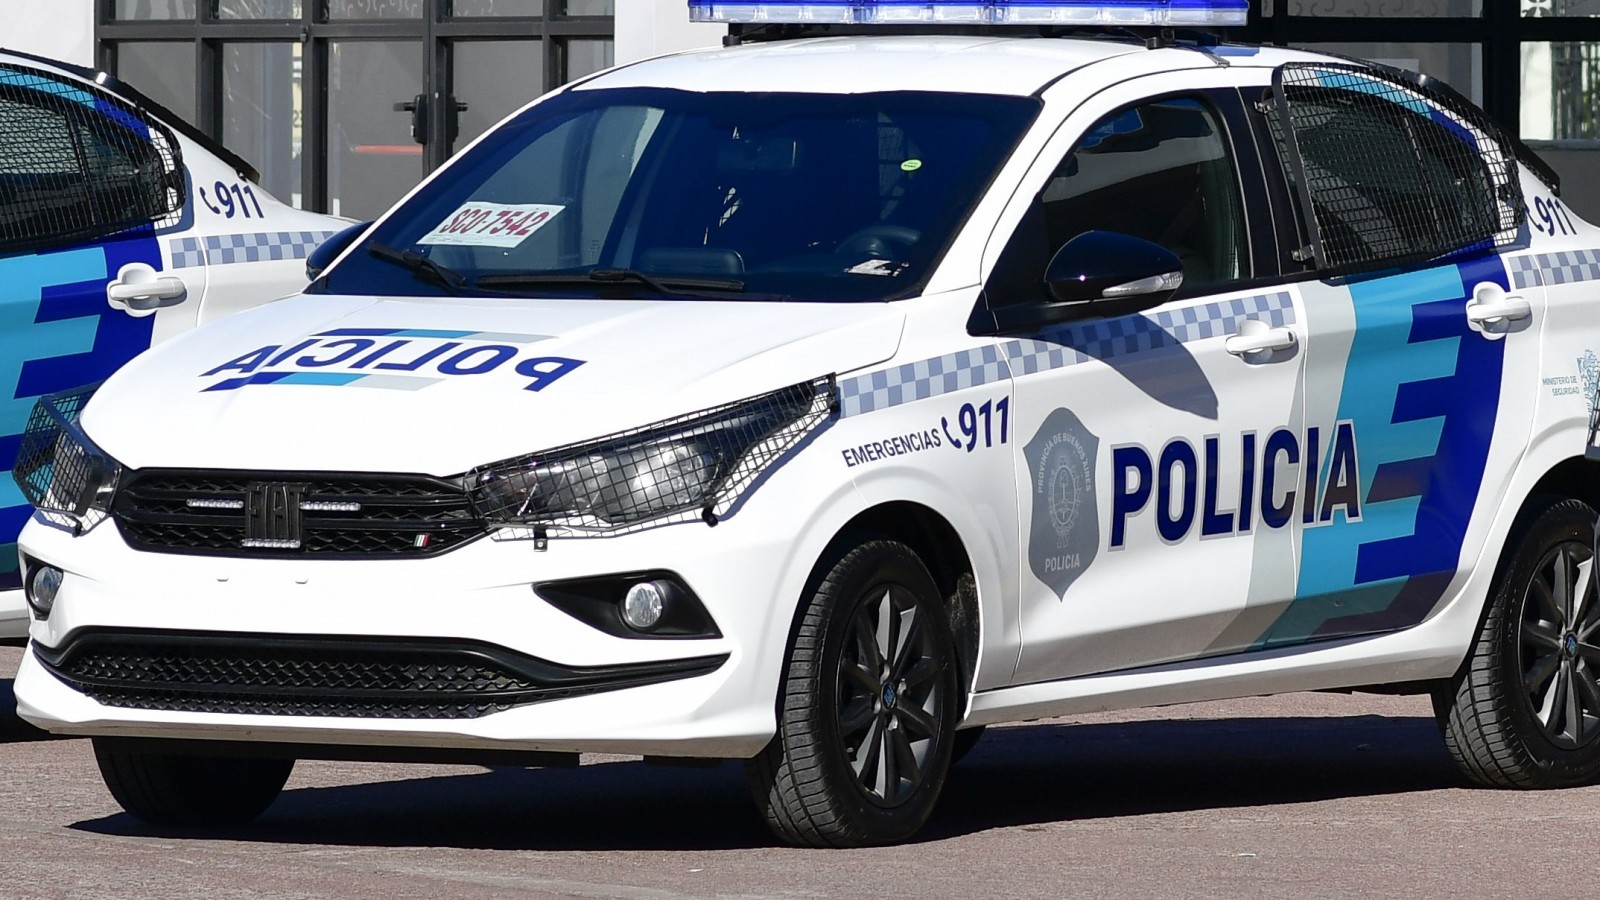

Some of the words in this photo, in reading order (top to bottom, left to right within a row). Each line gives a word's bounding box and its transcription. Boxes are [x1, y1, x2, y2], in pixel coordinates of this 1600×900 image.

[215, 181, 264, 219] 911
[1534, 195, 1577, 237] 911
[1542, 376, 1570, 386] MINISTERIO
[1570, 375, 1577, 384] DE
[1552, 386, 1579, 396] SEGURIDAD
[841, 428, 942, 468] EMERGENCIAS
[958, 395, 1009, 453] 911
[1052, 432, 1062, 445] DE
[1062, 432, 1086, 460] BUENOS
[1082, 458, 1092, 492] AIRES
[1108, 419, 1362, 553] POLICIA
[246, 482, 311, 540] FIAT
[1044, 552, 1081, 573] POLICIA
